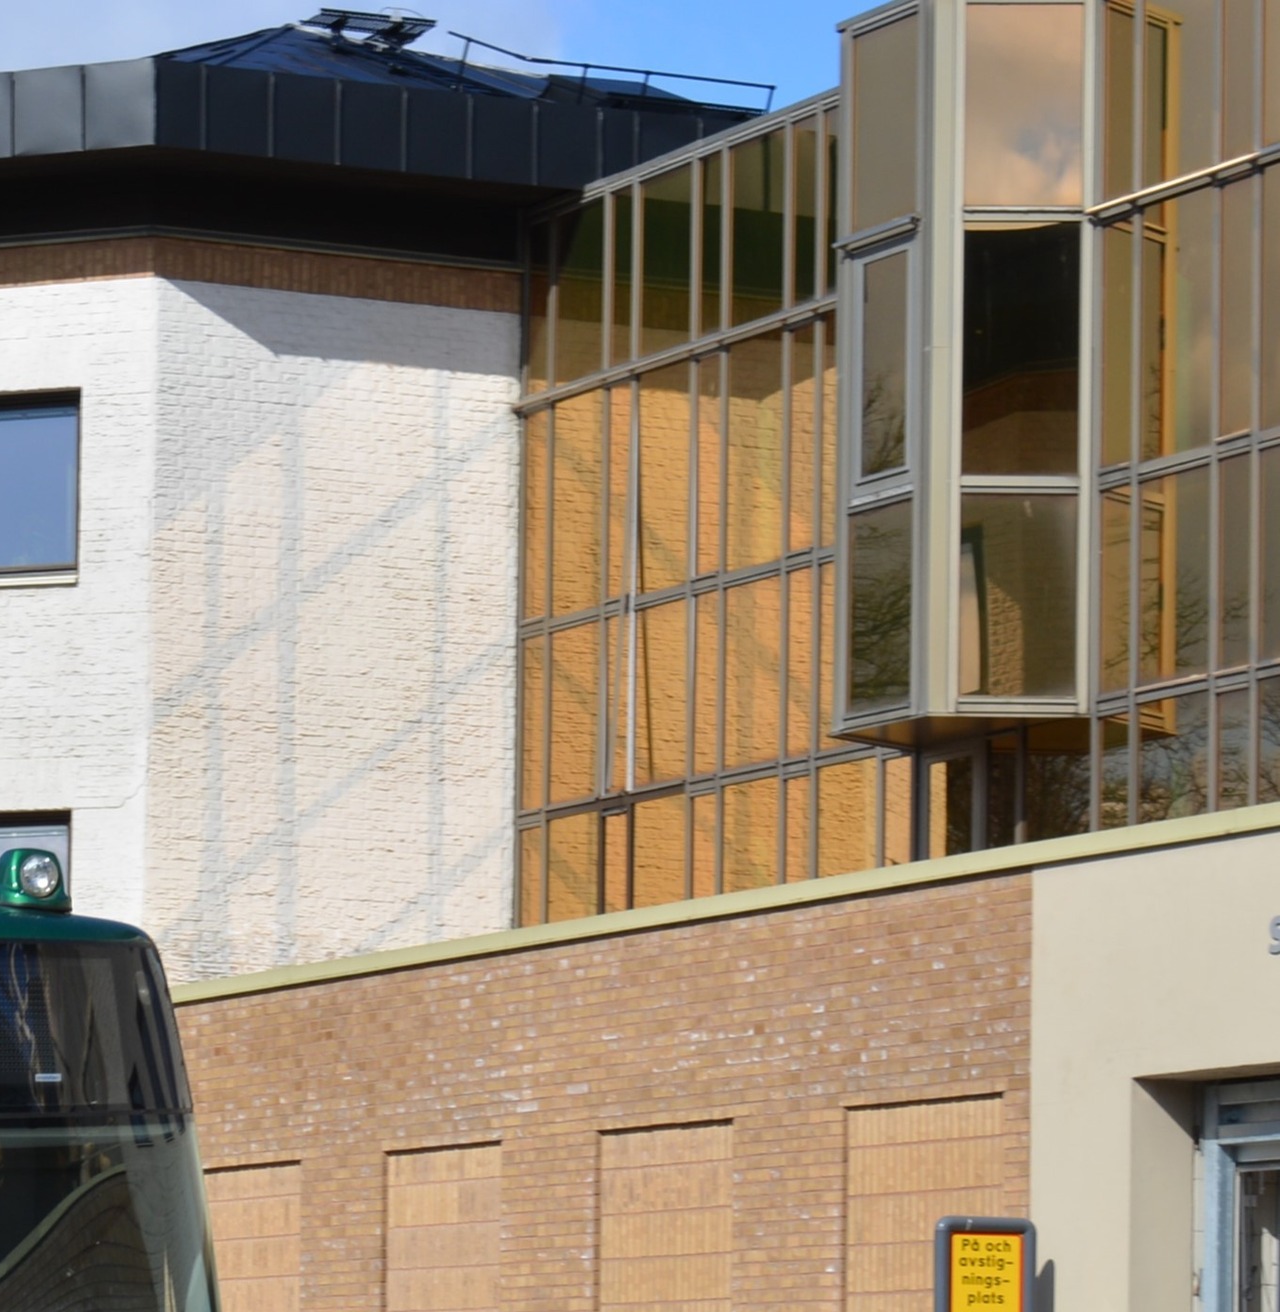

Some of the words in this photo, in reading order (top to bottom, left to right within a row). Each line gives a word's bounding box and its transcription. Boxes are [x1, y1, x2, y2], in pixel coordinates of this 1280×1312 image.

[961, 1238, 980, 1252] På
[985, 1240, 1012, 1252] och
[959, 1255, 1014, 1271] avstig-
[961, 1273, 1010, 1288] nings-
[966, 1291, 1005, 1306] plats
